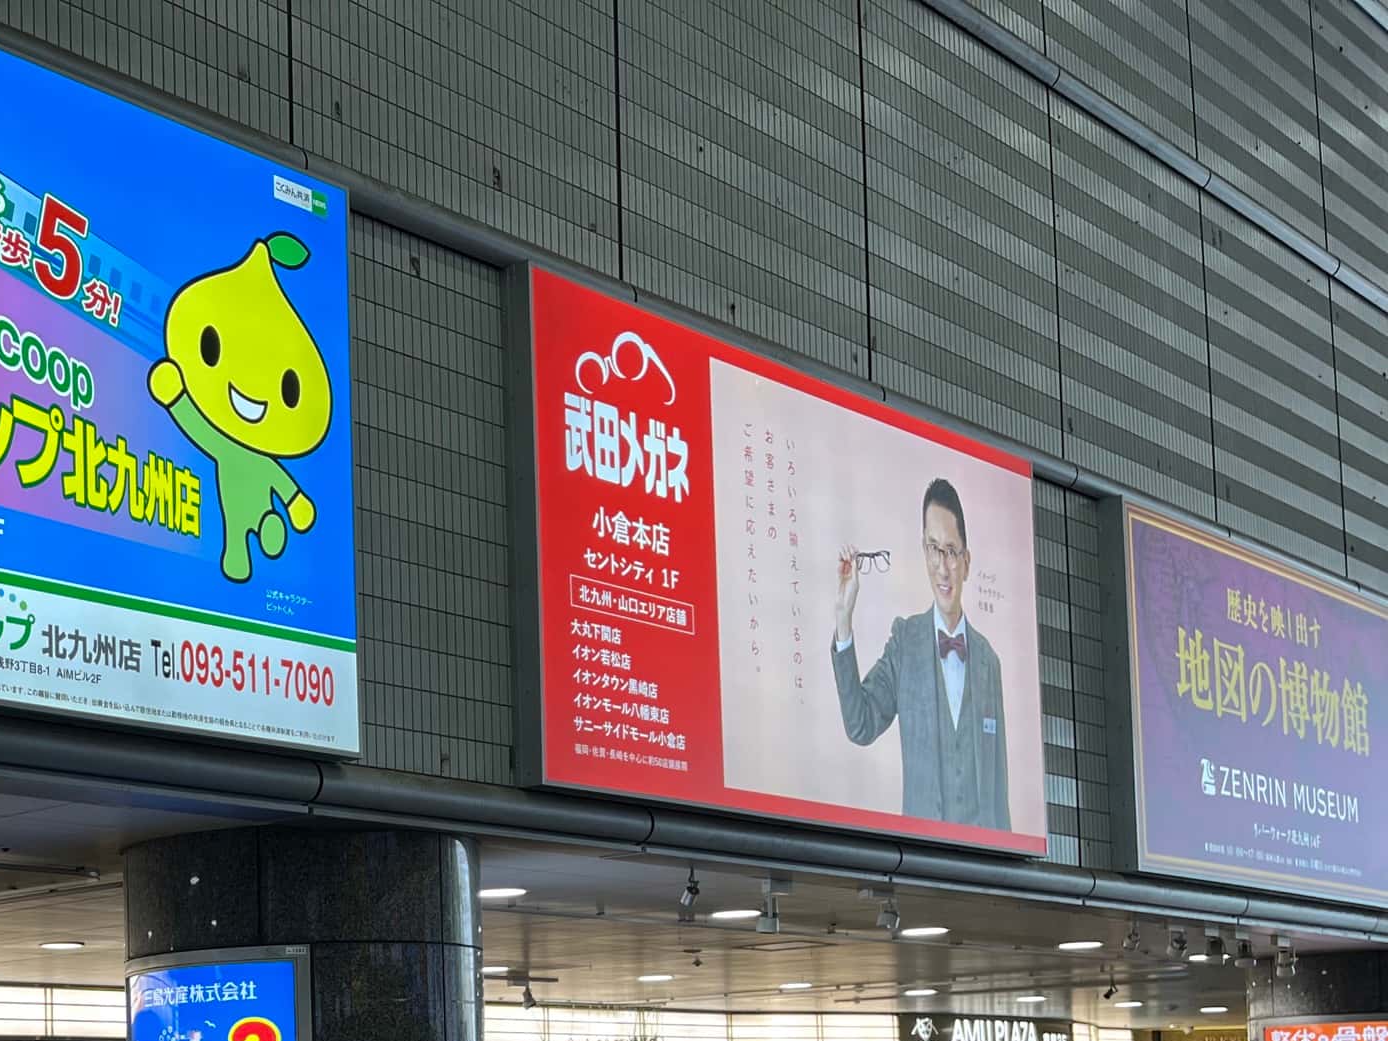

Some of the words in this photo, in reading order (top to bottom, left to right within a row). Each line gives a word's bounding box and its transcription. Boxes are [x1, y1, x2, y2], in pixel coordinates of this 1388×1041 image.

[564, 391, 690, 503] 武田メガネ
[592, 505, 671, 557] 小倉本店
[583, 547, 654, 585] セントシティ
[661, 567, 681, 590] 1F
[578, 584, 688, 627] 北九州・山口エリア店舗
[1226, 587, 1322, 649] 歴史を映し出す
[41, 623, 142, 673] 北九州店
[572, 643, 632, 671] イオン若松店
[55, 669, 103, 685] AIMビル2F
[572, 667, 659, 700] イオンタウン黒崎店
[1175, 624, 1371, 758] 地図の博物館
[573, 691, 670, 725] イオンモール八幡東店
[573, 715, 687, 751] サニーサイドモール小倉店
[1219, 765, 1287, 809] ZENRIN
[1293, 782, 1359, 824] MUSEUM
